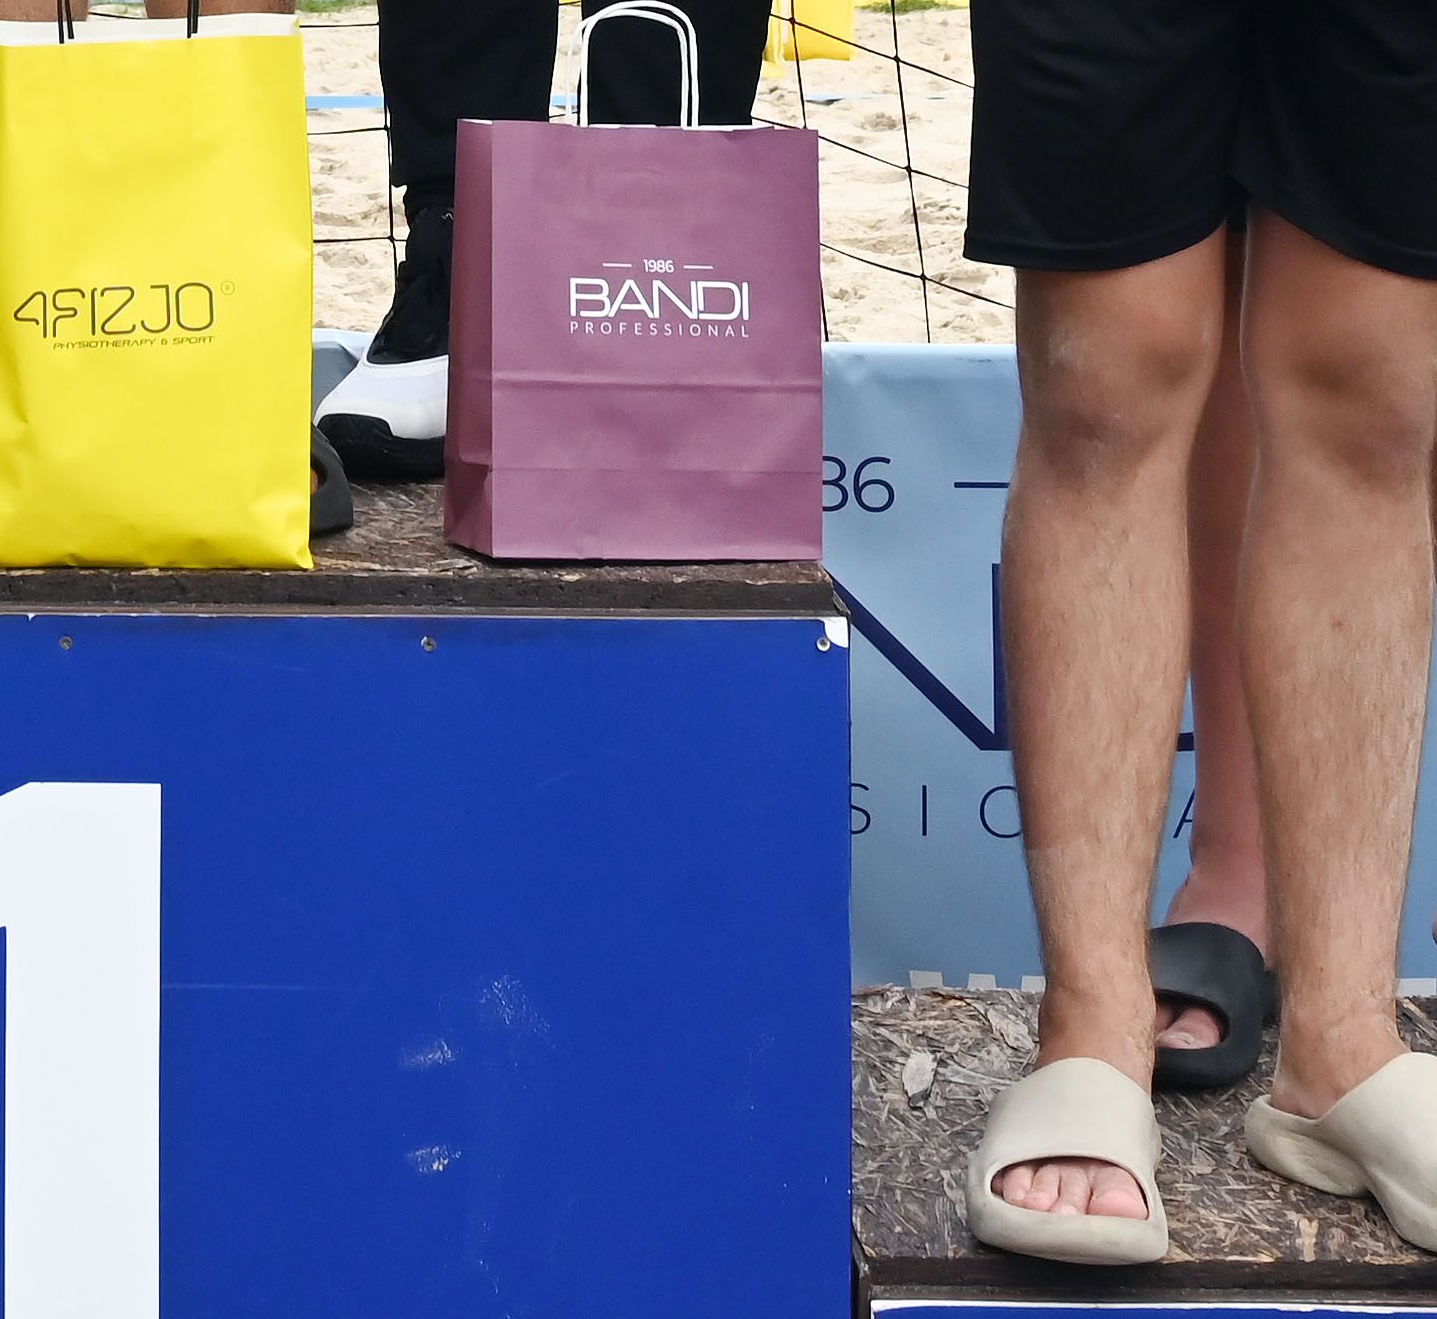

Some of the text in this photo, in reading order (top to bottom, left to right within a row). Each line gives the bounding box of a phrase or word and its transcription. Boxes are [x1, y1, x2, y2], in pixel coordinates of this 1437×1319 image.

[642, 258, 675, 275] 1986
[13, 281, 216, 339] 4FIZJO
[569, 277, 750, 321] BANDI
[569, 320, 750, 339] PROFESSIONAL
